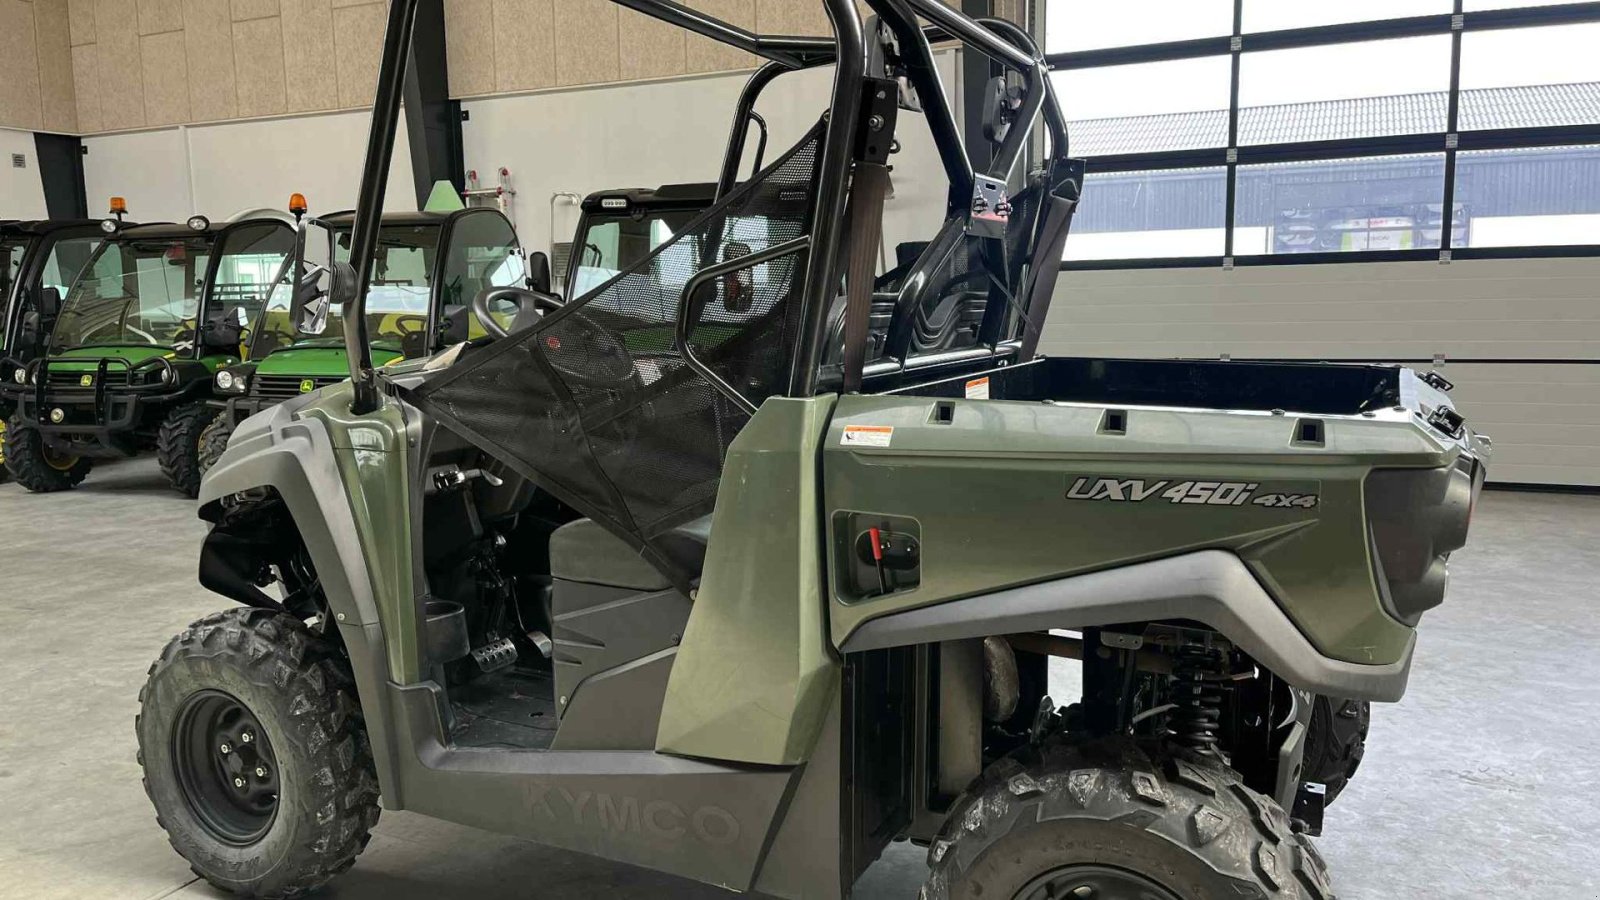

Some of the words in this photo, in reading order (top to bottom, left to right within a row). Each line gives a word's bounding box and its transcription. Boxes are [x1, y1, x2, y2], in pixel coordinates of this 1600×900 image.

[1066, 477, 1169, 501] UXV
[1161, 481, 1260, 506] 450i
[522, 784, 740, 844] KYMCO
